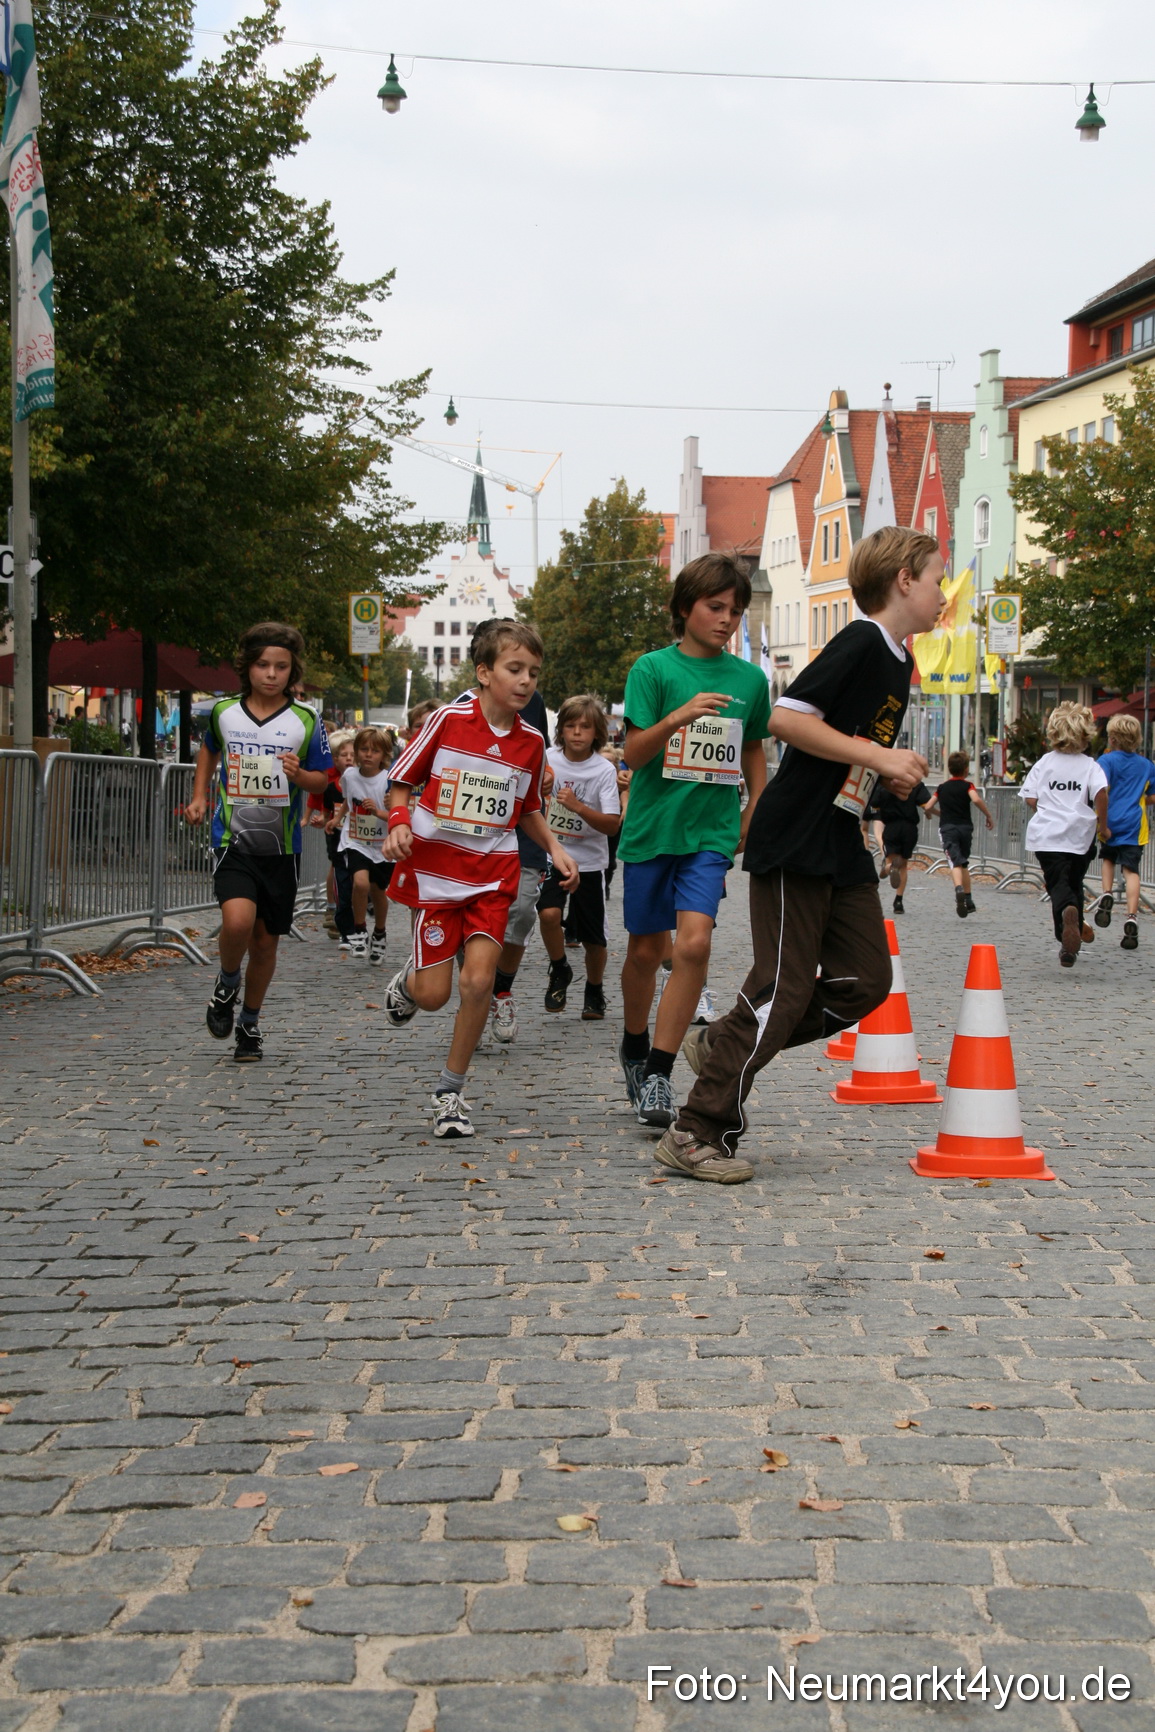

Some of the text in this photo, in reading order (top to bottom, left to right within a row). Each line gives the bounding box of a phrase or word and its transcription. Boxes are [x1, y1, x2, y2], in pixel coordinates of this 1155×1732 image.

[360, 603, 371, 617] H
[998, 604, 1009, 617] H
[690, 721, 723, 735] Fabian
[228, 731, 258, 739] TEAM
[670, 738, 680, 748] K6
[690, 741, 736, 763] 7060
[241, 759, 258, 770] Luca
[242, 775, 281, 790] 7161
[462, 772, 511, 792] Ferdinand
[1049, 781, 1082, 791] Volk
[441, 788, 452, 798] K6
[461, 792, 508, 817] 7138
[550, 814, 583, 831] 7253
[358, 826, 383, 836] 7054
